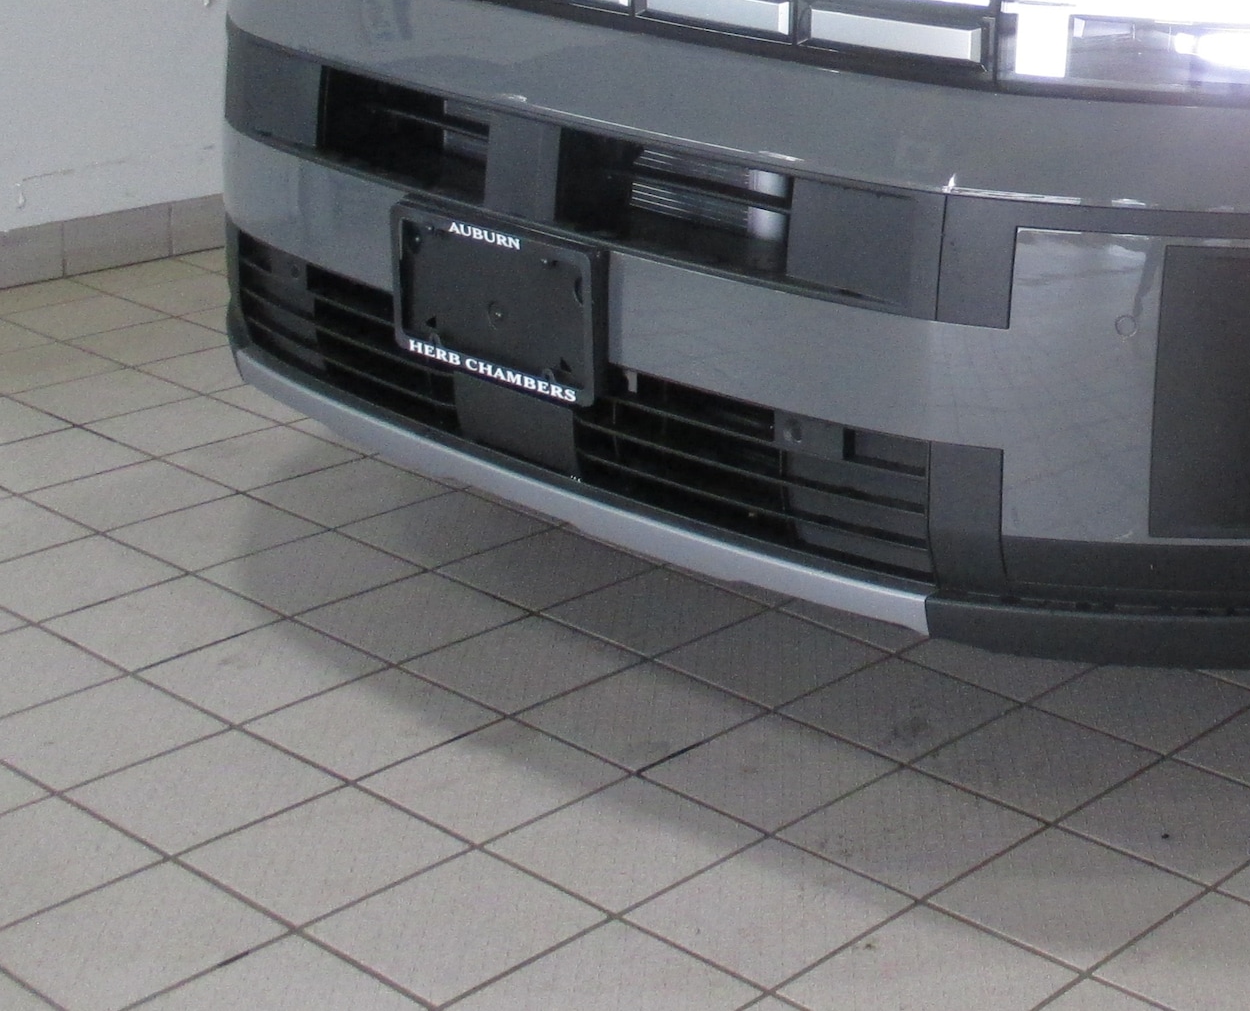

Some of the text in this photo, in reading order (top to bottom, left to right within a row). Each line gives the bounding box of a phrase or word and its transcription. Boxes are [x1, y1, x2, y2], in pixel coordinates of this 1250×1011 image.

[448, 221, 521, 250] AUBURN
[408, 339, 577, 402] HERB CHAMBERS
